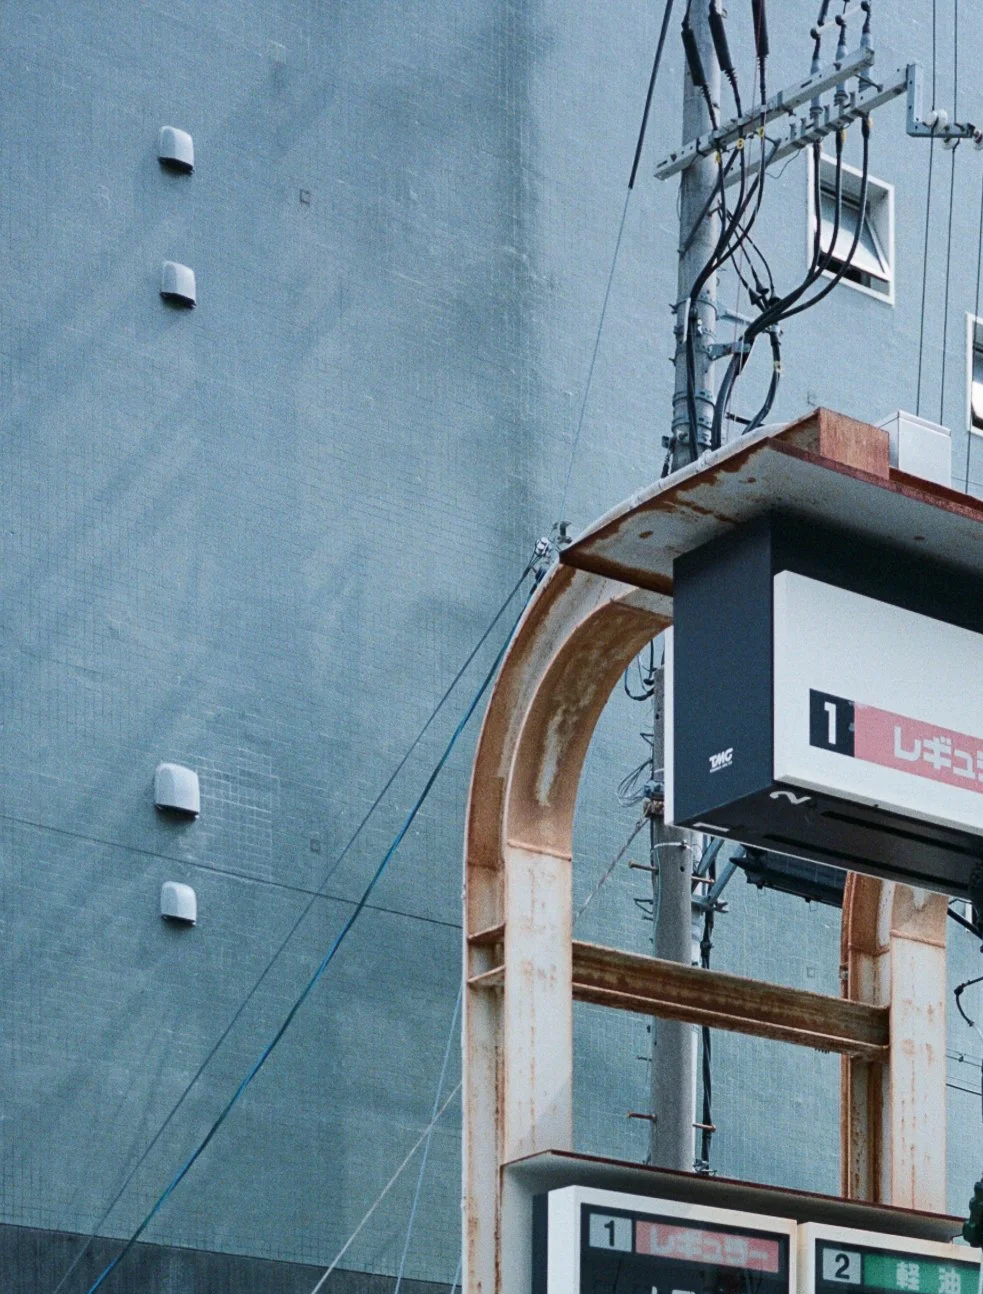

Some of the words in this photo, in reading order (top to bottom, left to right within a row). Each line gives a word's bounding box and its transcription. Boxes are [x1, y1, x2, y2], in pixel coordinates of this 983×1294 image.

[824, 701, 837, 745] 1
[604, 1220, 615, 1247] 1
[650, 1224, 769, 1265] レギュラー
[834, 1253, 851, 1280] 2
